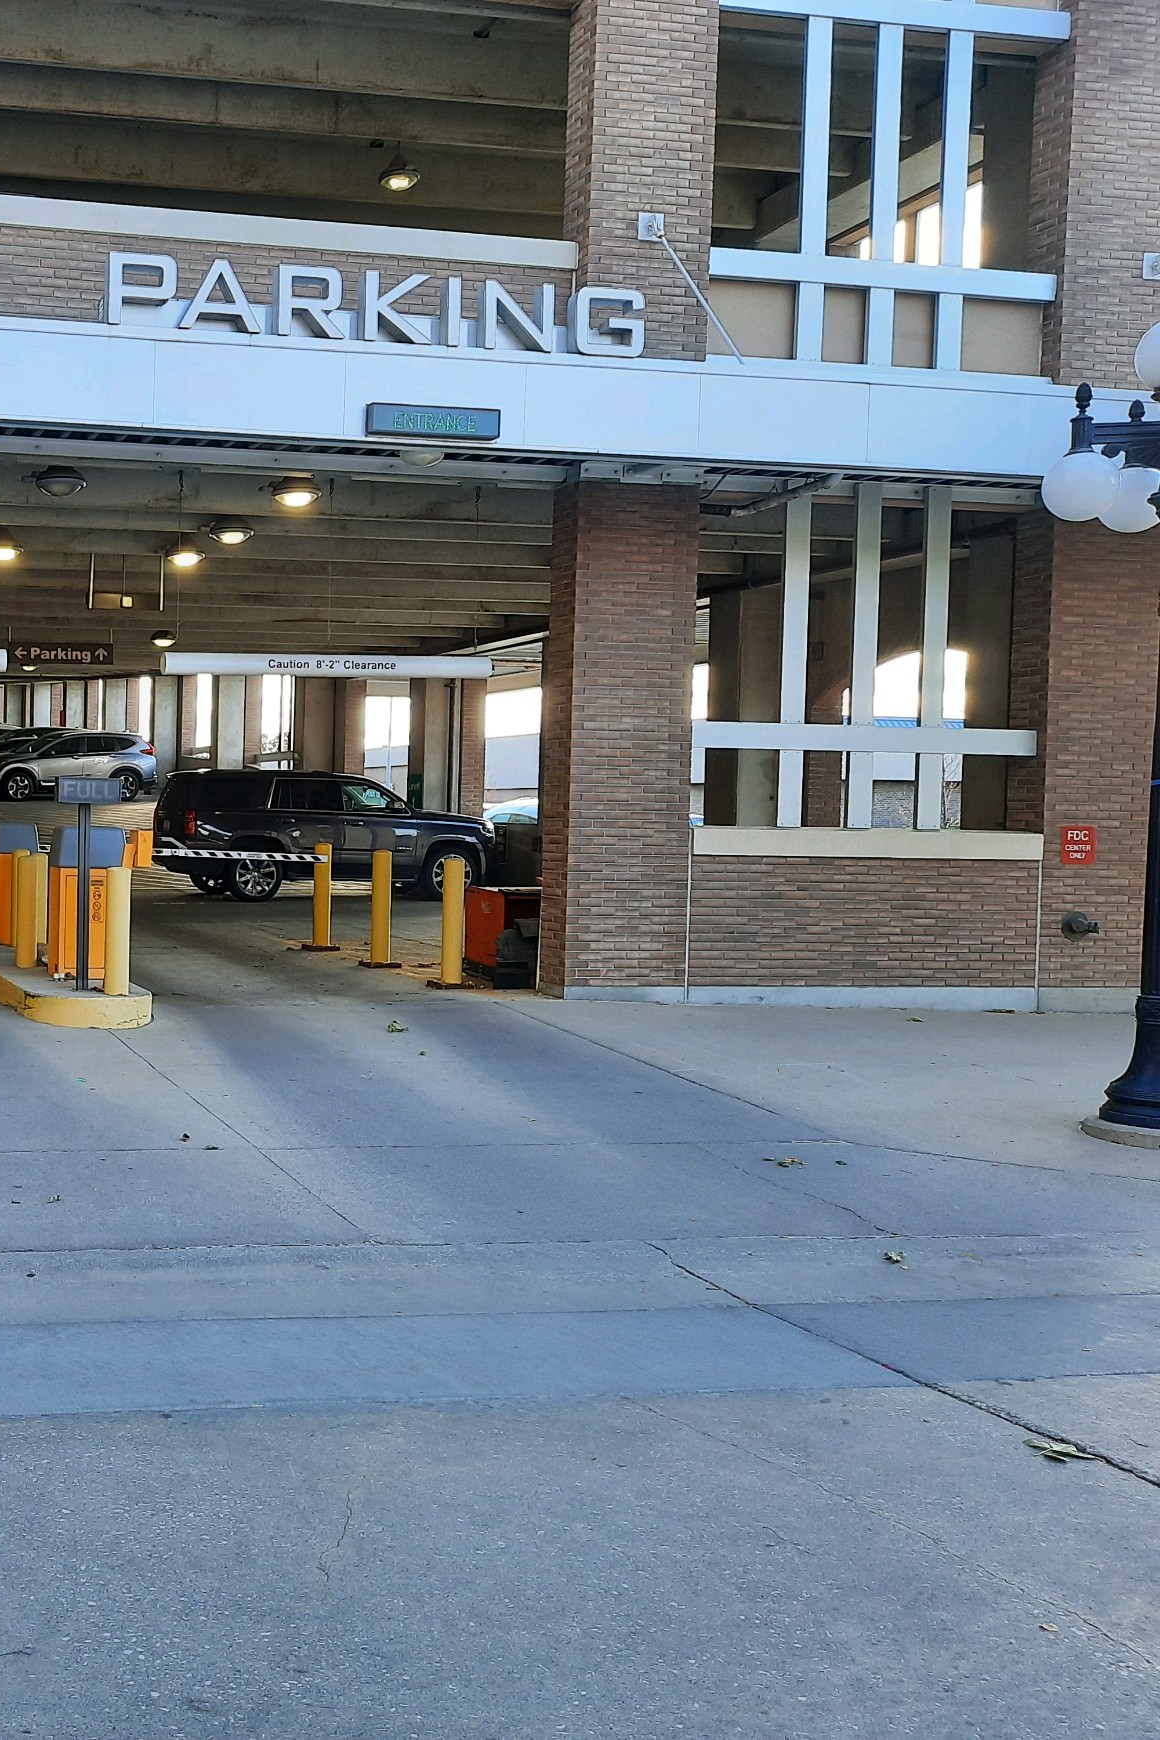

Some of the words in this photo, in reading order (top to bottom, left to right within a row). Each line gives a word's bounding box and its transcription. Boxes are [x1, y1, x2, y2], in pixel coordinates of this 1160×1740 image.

[100, 250, 646, 358] PARKING
[393, 411, 478, 433] ENTRANCE
[30, 647, 92, 663] Parking
[268, 659, 310, 669] Caution
[316, 660, 341, 669] 8'-2"
[343, 660, 397, 670] Clearance
[63, 780, 112, 798] FULL
[1067, 830, 1089, 841] FDC
